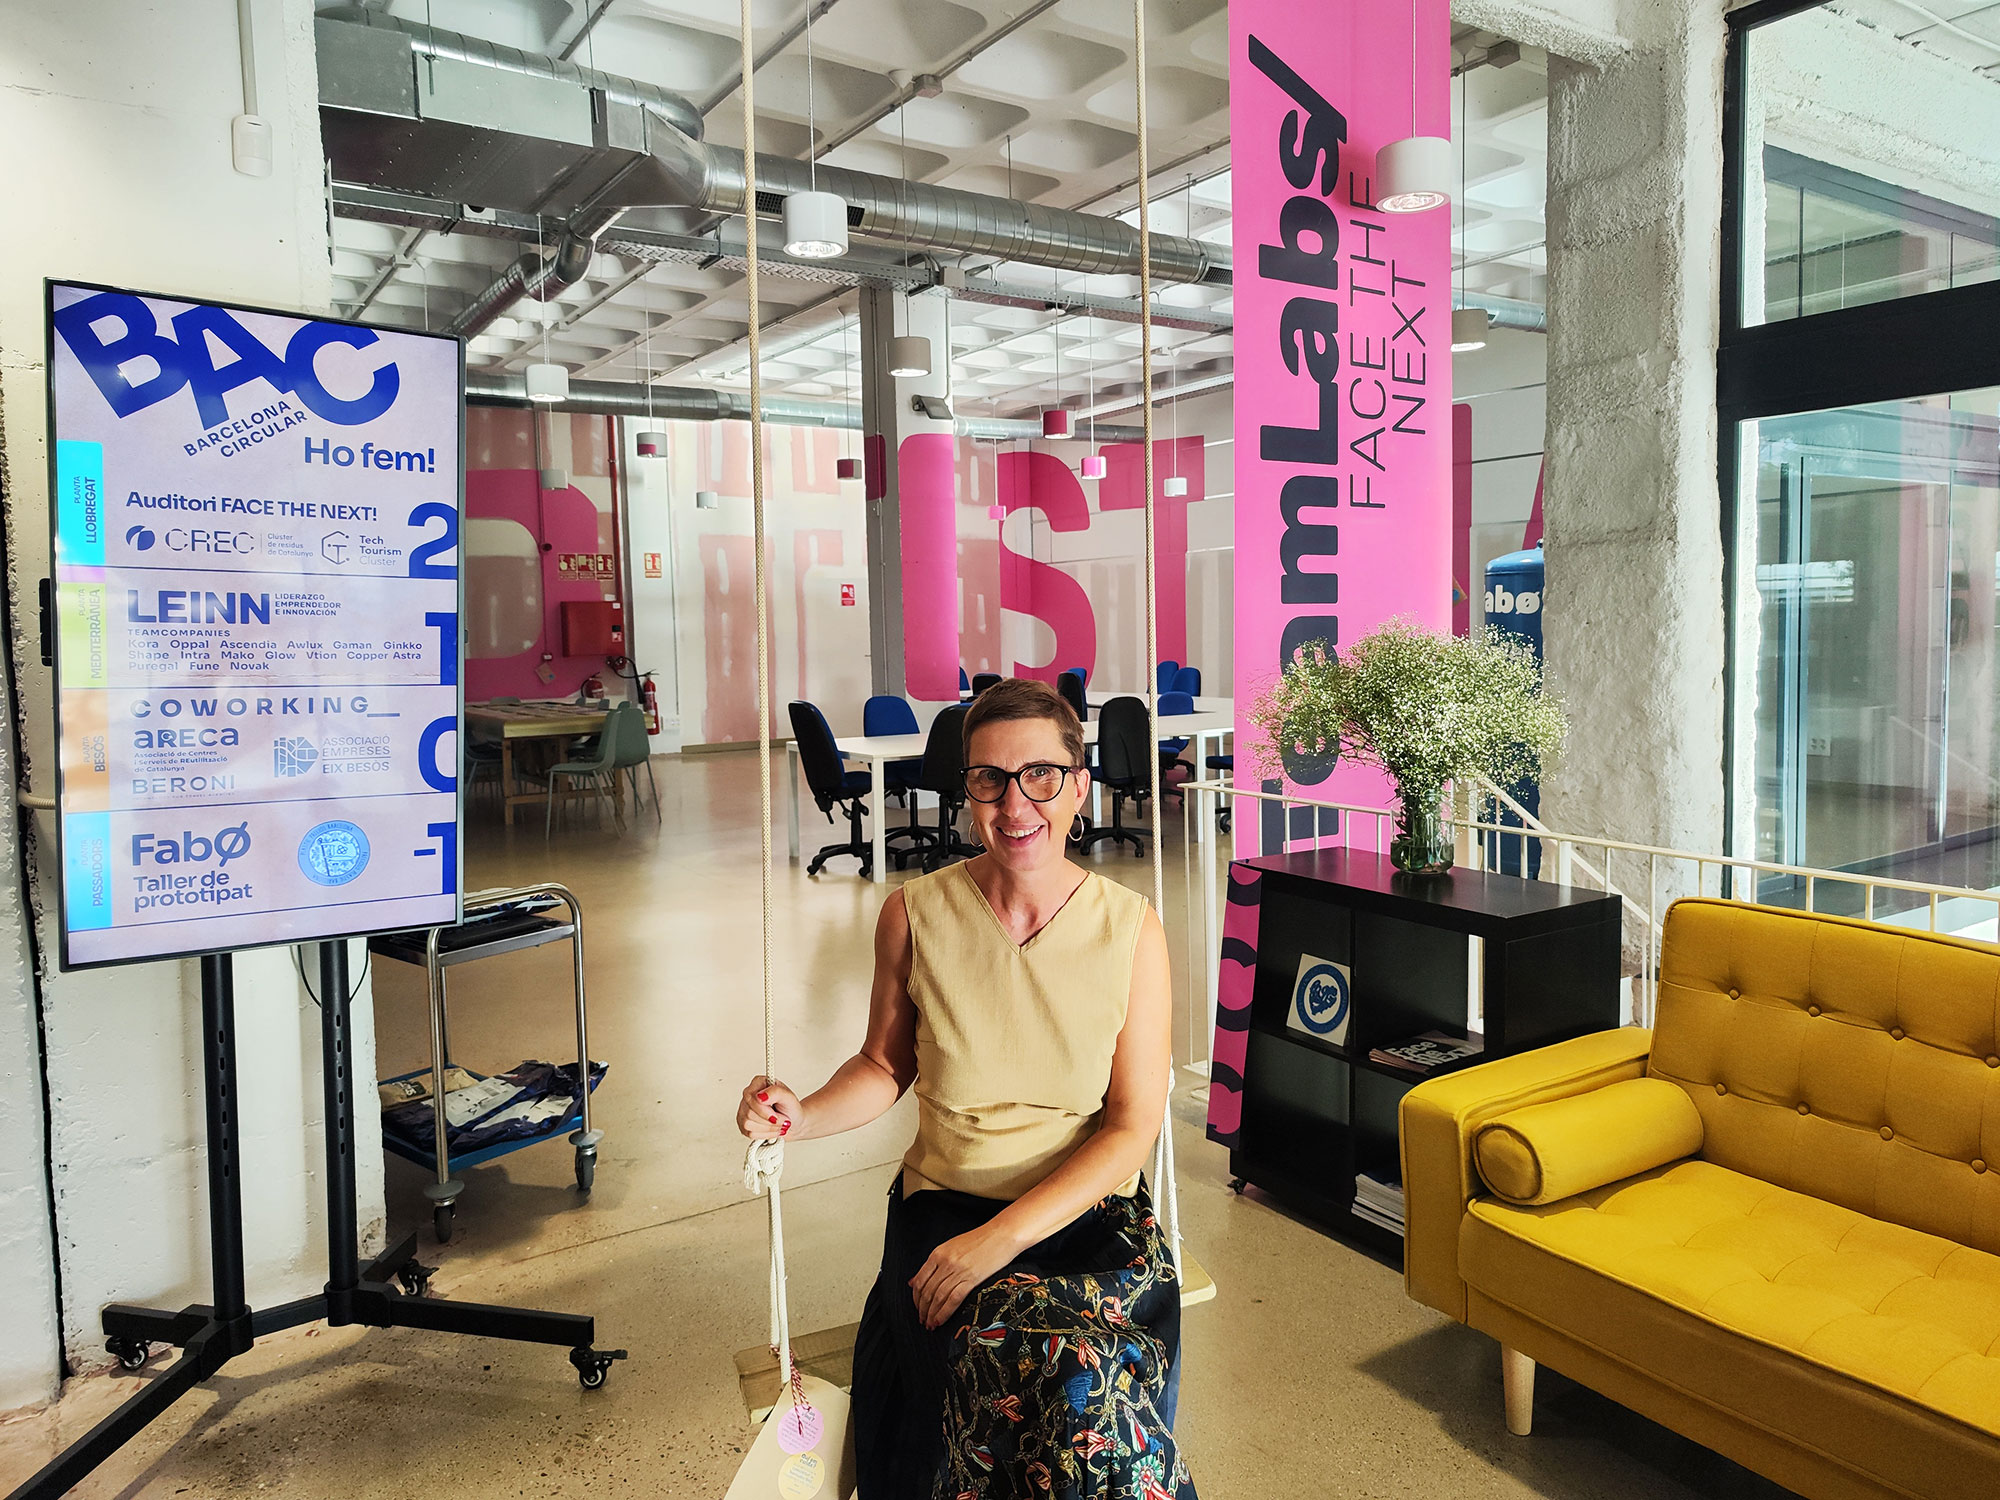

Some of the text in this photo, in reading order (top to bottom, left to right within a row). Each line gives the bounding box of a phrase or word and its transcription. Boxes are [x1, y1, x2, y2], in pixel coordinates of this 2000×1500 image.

[1350, 171, 1386, 508] FACE THE
[1391, 258, 1426, 435] NEXT
[54, 291, 400, 430] BAC
[183, 400, 292, 457] BARCELONA
[220, 410, 308, 458] CIRCULAR
[304, 437, 435, 473] Ho fem!
[84, 476, 97, 544] LLOBREGAT
[126, 491, 377, 521] Auditori FACE THE NEXT!
[165, 528, 255, 554] CREC
[359, 535, 384, 545] Tech
[359, 545, 402, 556] Tourism
[407, 502, 457, 578] 2
[360, 556, 397, 566] Cluster
[128, 589, 270, 625] LEINN
[274, 593, 326, 601] LIDERAZGO
[274, 601, 341, 609] EMPRENDEDOR
[1483, 584, 1540, 615] abø
[283, 608, 337, 616] INNOVACIÓN
[127, 629, 231, 637] TEAMCOMPANIES
[128, 640, 423, 650] Kora Oppal Ascendia Awlux Gaman Ginkko
[128, 651, 170, 661] Shape
[180, 651, 210, 660] Intra
[221, 651, 255, 660] Mako
[265, 651, 296, 660] Glow
[346, 651, 388, 661] Copper
[393, 652, 422, 660] Astra
[424, 612, 457, 686] 1
[190, 662, 220, 671] Fune
[230, 661, 270, 671] Novak
[322, 746, 391, 757] EMPRESES
[322, 762, 343, 774] EIX
[132, 775, 235, 794] BERONI
[92, 838, 103, 906] PASSADORS
[133, 870, 230, 893] Taller de
[134, 883, 253, 912] prototipat
[1384, 1041, 1437, 1058] Face
